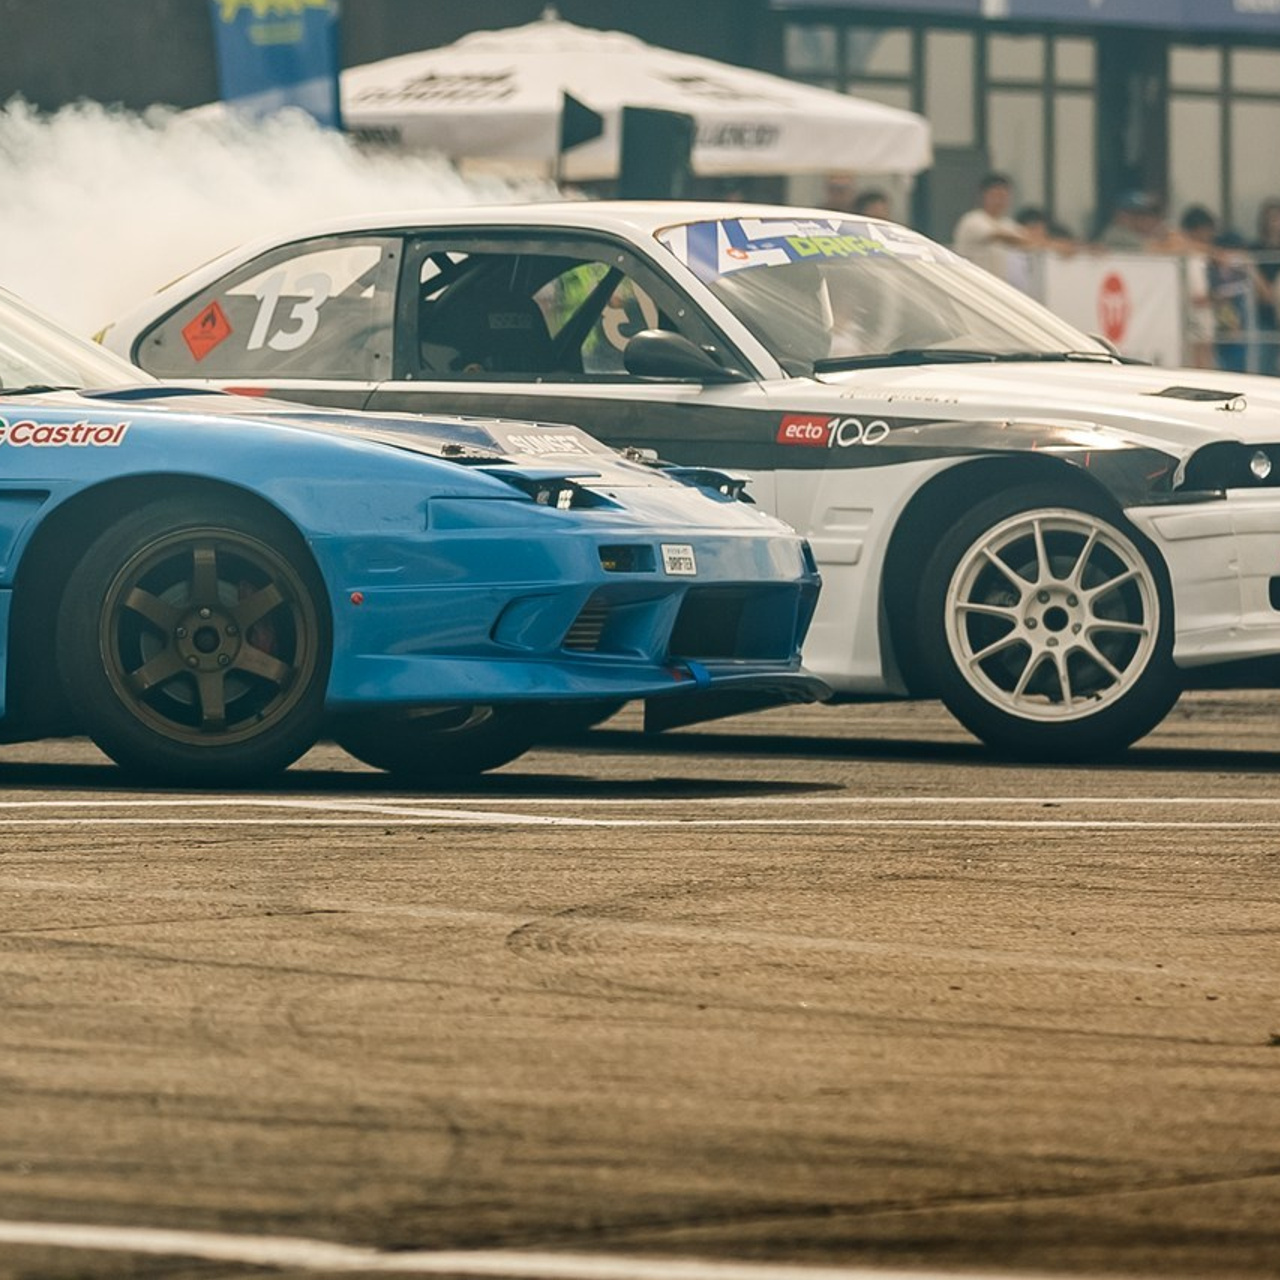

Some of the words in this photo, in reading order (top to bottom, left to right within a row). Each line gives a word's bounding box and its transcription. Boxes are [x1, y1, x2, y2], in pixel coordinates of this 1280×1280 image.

[247, 271, 333, 352] 13
[9, 423, 126, 445] Castrol
[785, 423, 823, 439] ecto
